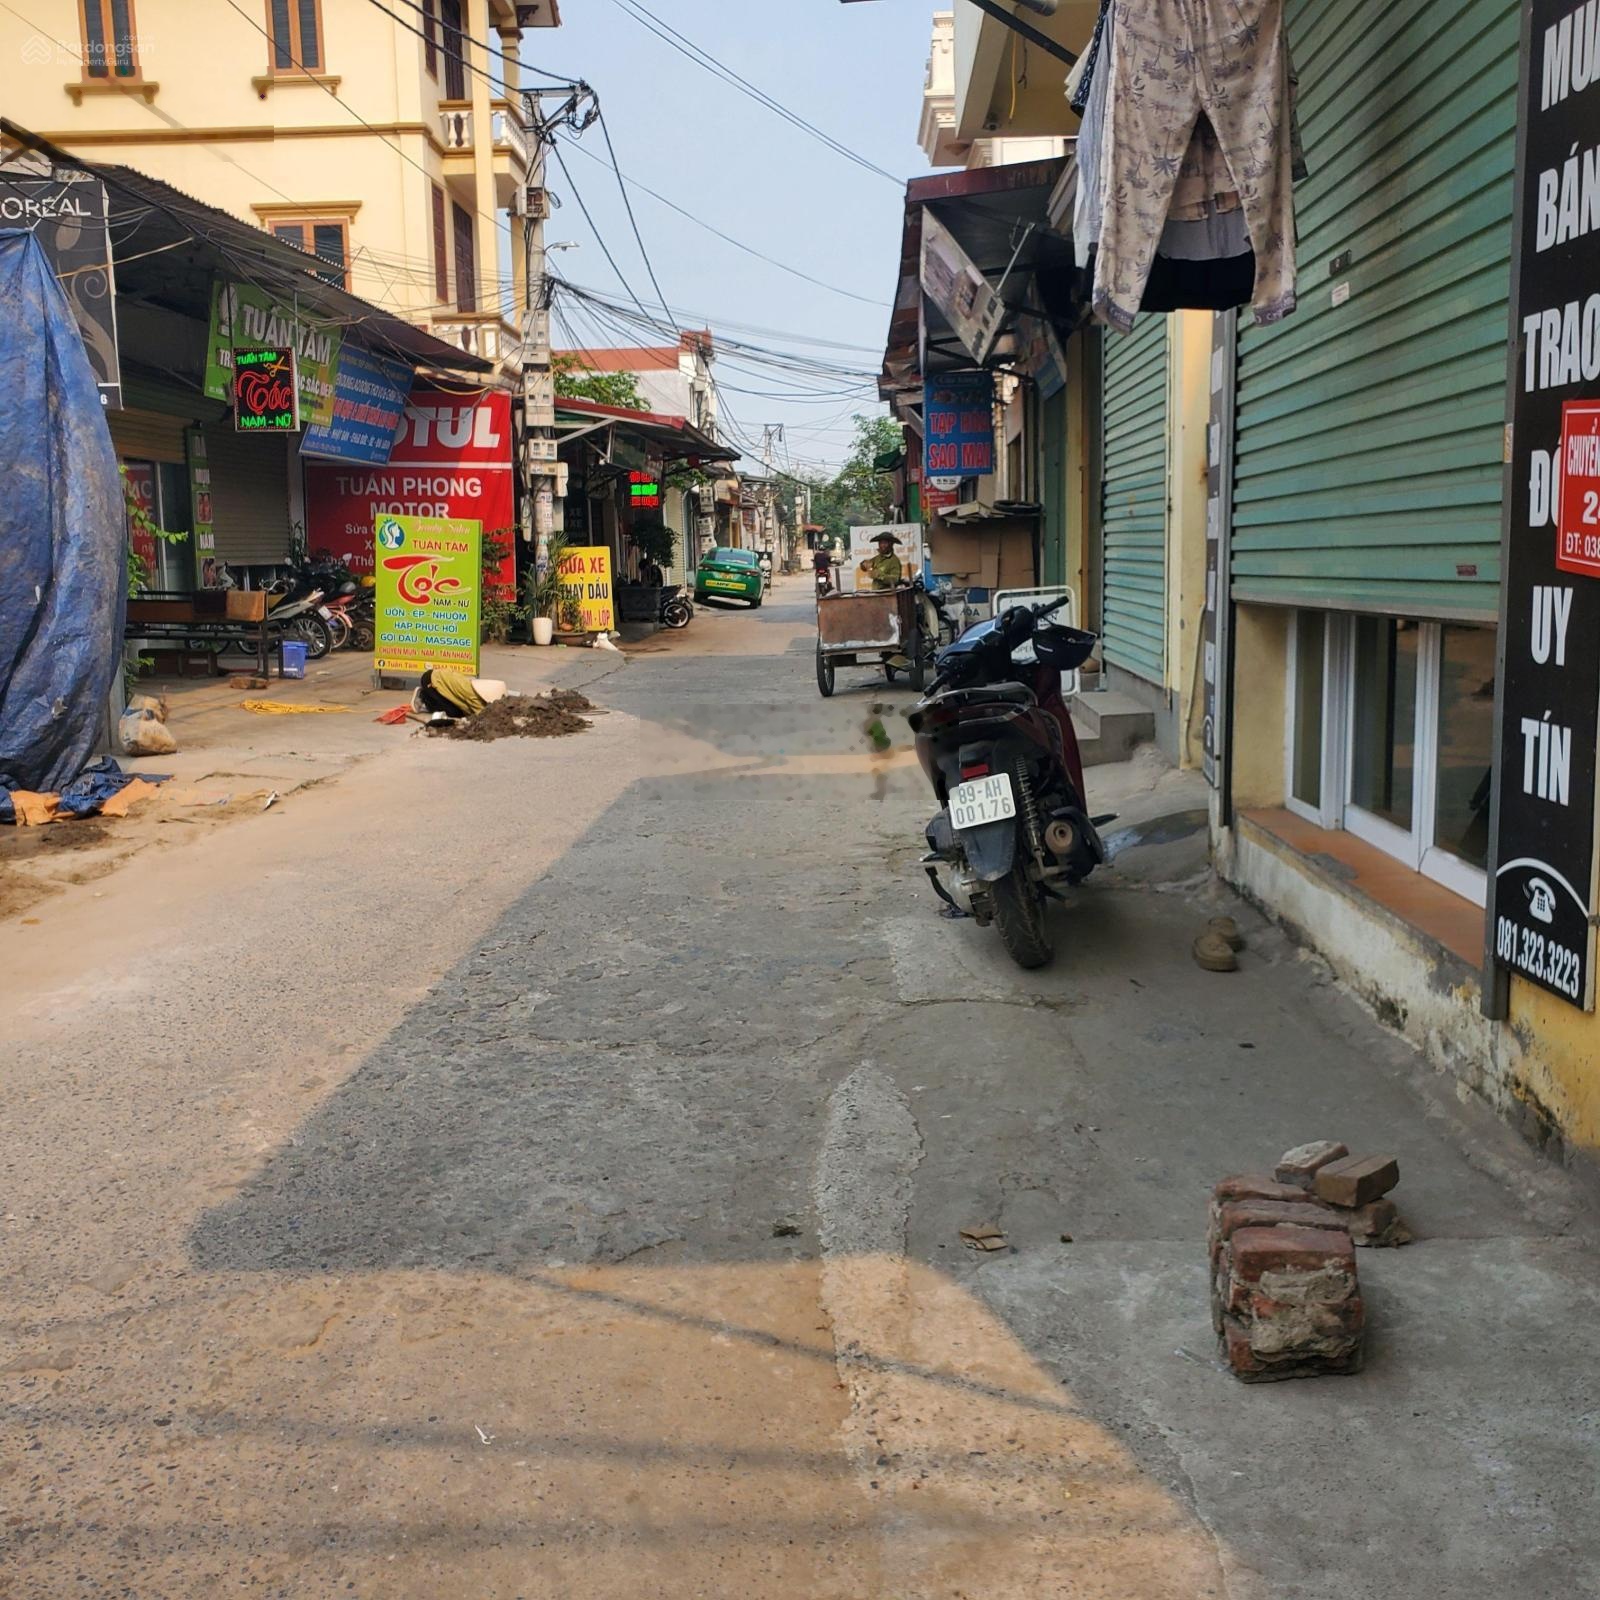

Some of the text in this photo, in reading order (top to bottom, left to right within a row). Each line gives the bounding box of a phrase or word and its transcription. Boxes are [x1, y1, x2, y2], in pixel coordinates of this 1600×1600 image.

[1536, 141, 1600, 253] BÁN
[1523, 293, 1600, 392] TRAO
[238, 371, 291, 416] Tóc
[241, 415, 267, 428] NAM
[928, 442, 992, 470] SAO MAI
[403, 476, 482, 497] PHONG
[370, 501, 449, 521] MOTOR
[590, 556, 605, 573] XE
[1530, 585, 1574, 666] UY
[425, 636, 472, 647] MASSAGE
[1521, 709, 1572, 806] TÍN
[959, 779, 1002, 804] 89-AH
[1497, 915, 1580, 998] 081.323.3223
